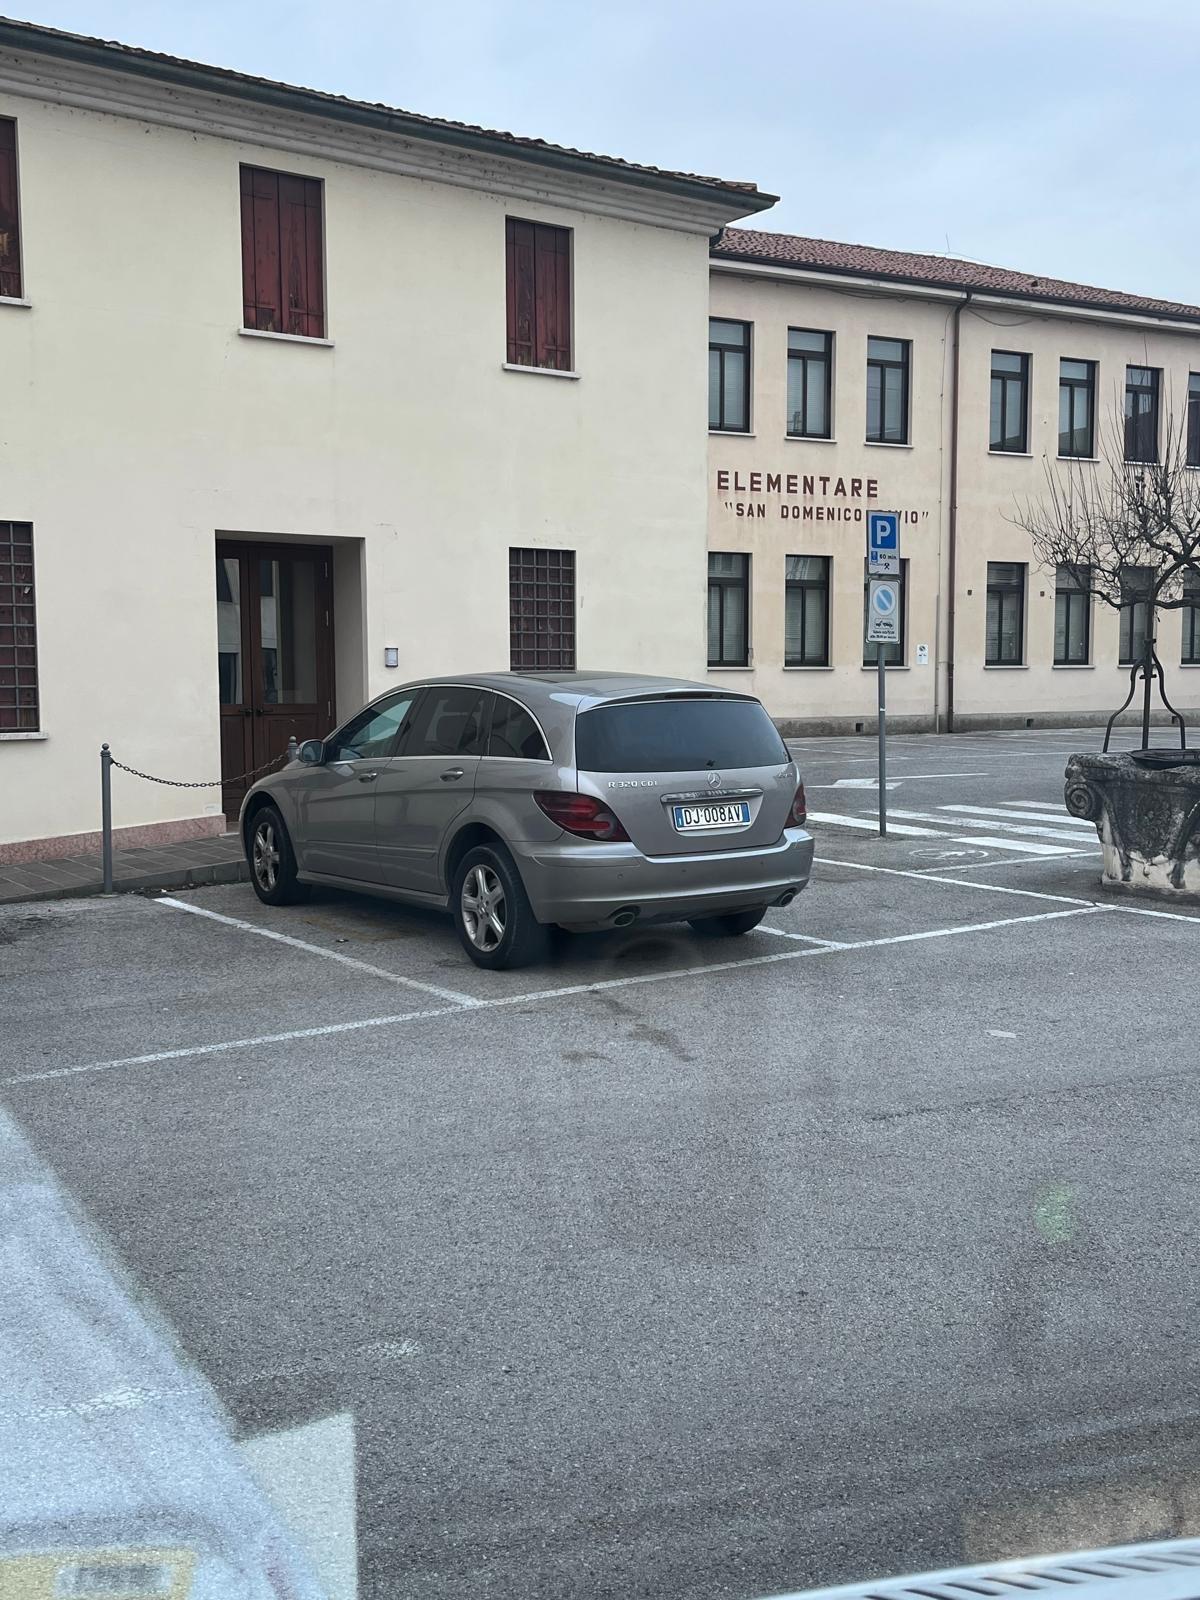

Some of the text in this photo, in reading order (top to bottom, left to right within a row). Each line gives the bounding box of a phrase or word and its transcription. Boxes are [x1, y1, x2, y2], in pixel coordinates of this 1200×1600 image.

[717, 470, 879, 498] ELEMENTARE
[780, 504, 862, 522] DOMENICO
[876, 520, 891, 545] P
[618, 780, 637, 788] 320
